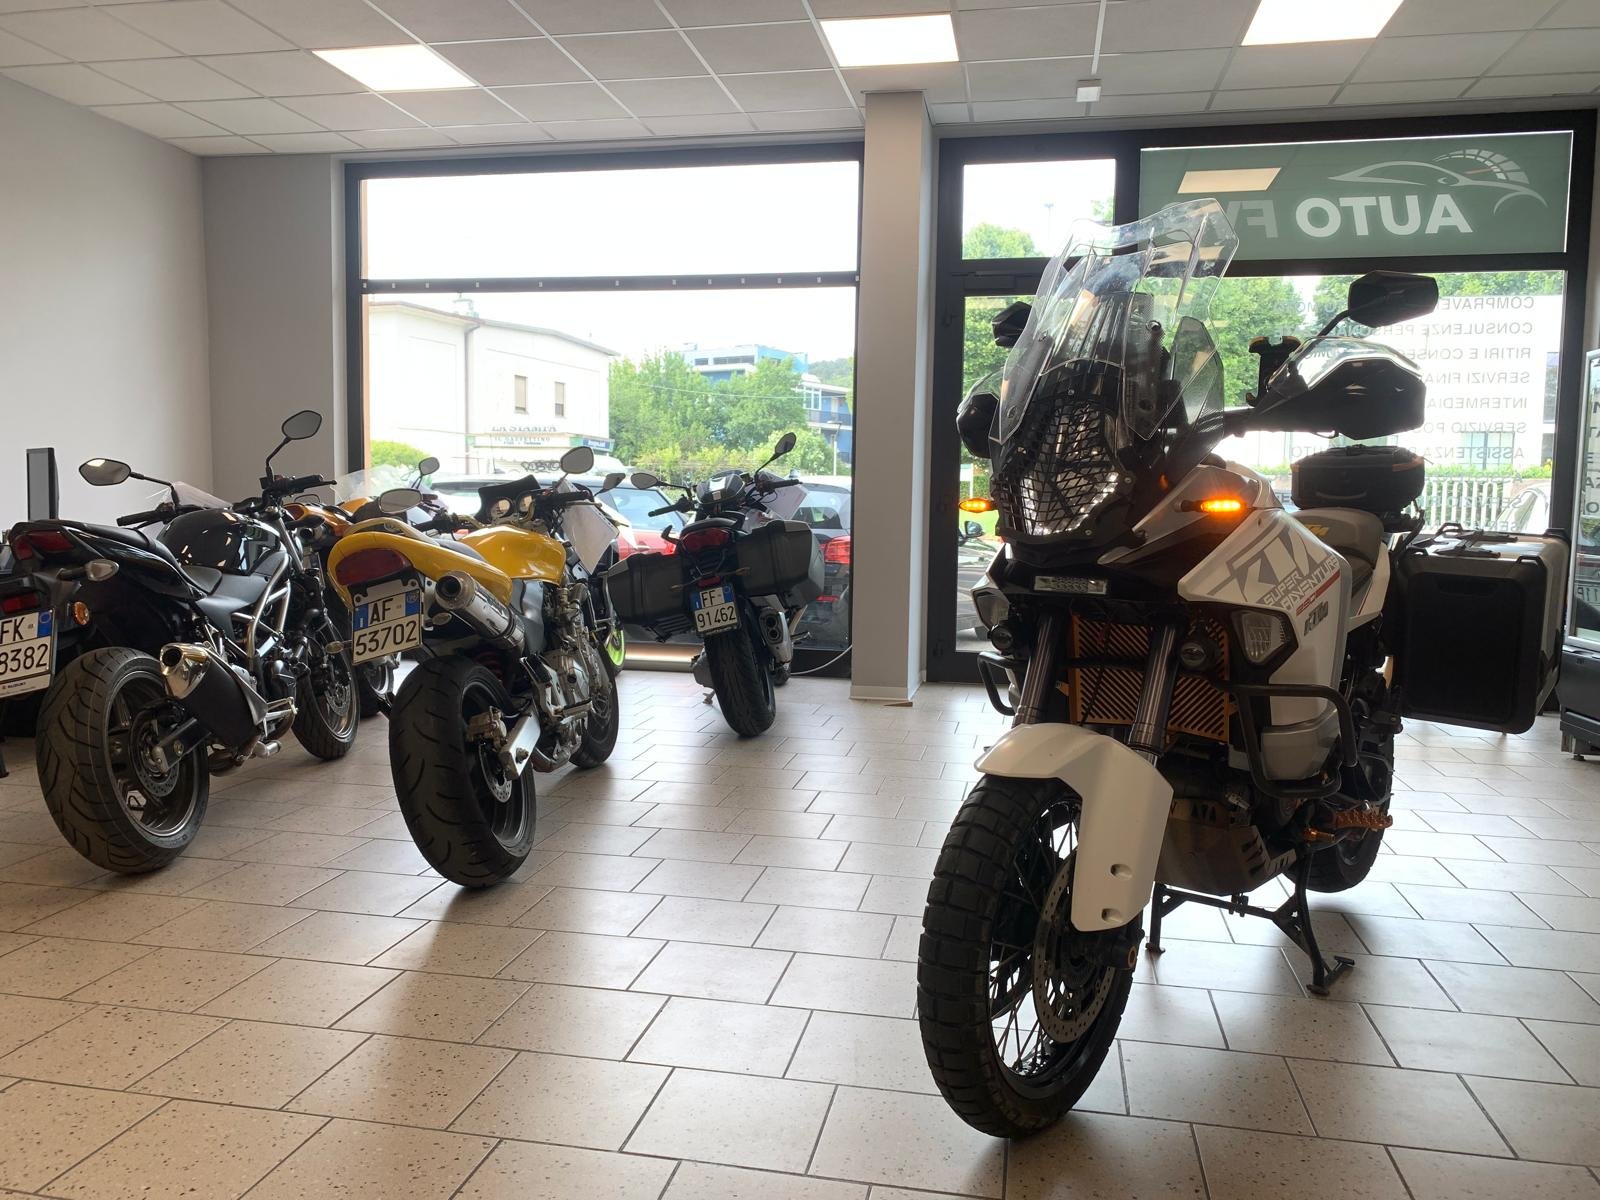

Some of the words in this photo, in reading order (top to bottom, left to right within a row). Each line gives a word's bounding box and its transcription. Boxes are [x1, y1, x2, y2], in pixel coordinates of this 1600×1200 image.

[701, 589, 716, 607] FF
[1263, 569, 1305, 607] SUPER
[369, 597, 394, 625] AF
[697, 605, 736, 628] 91462
[0, 616, 25, 645] FK
[355, 620, 418, 656] 53702
